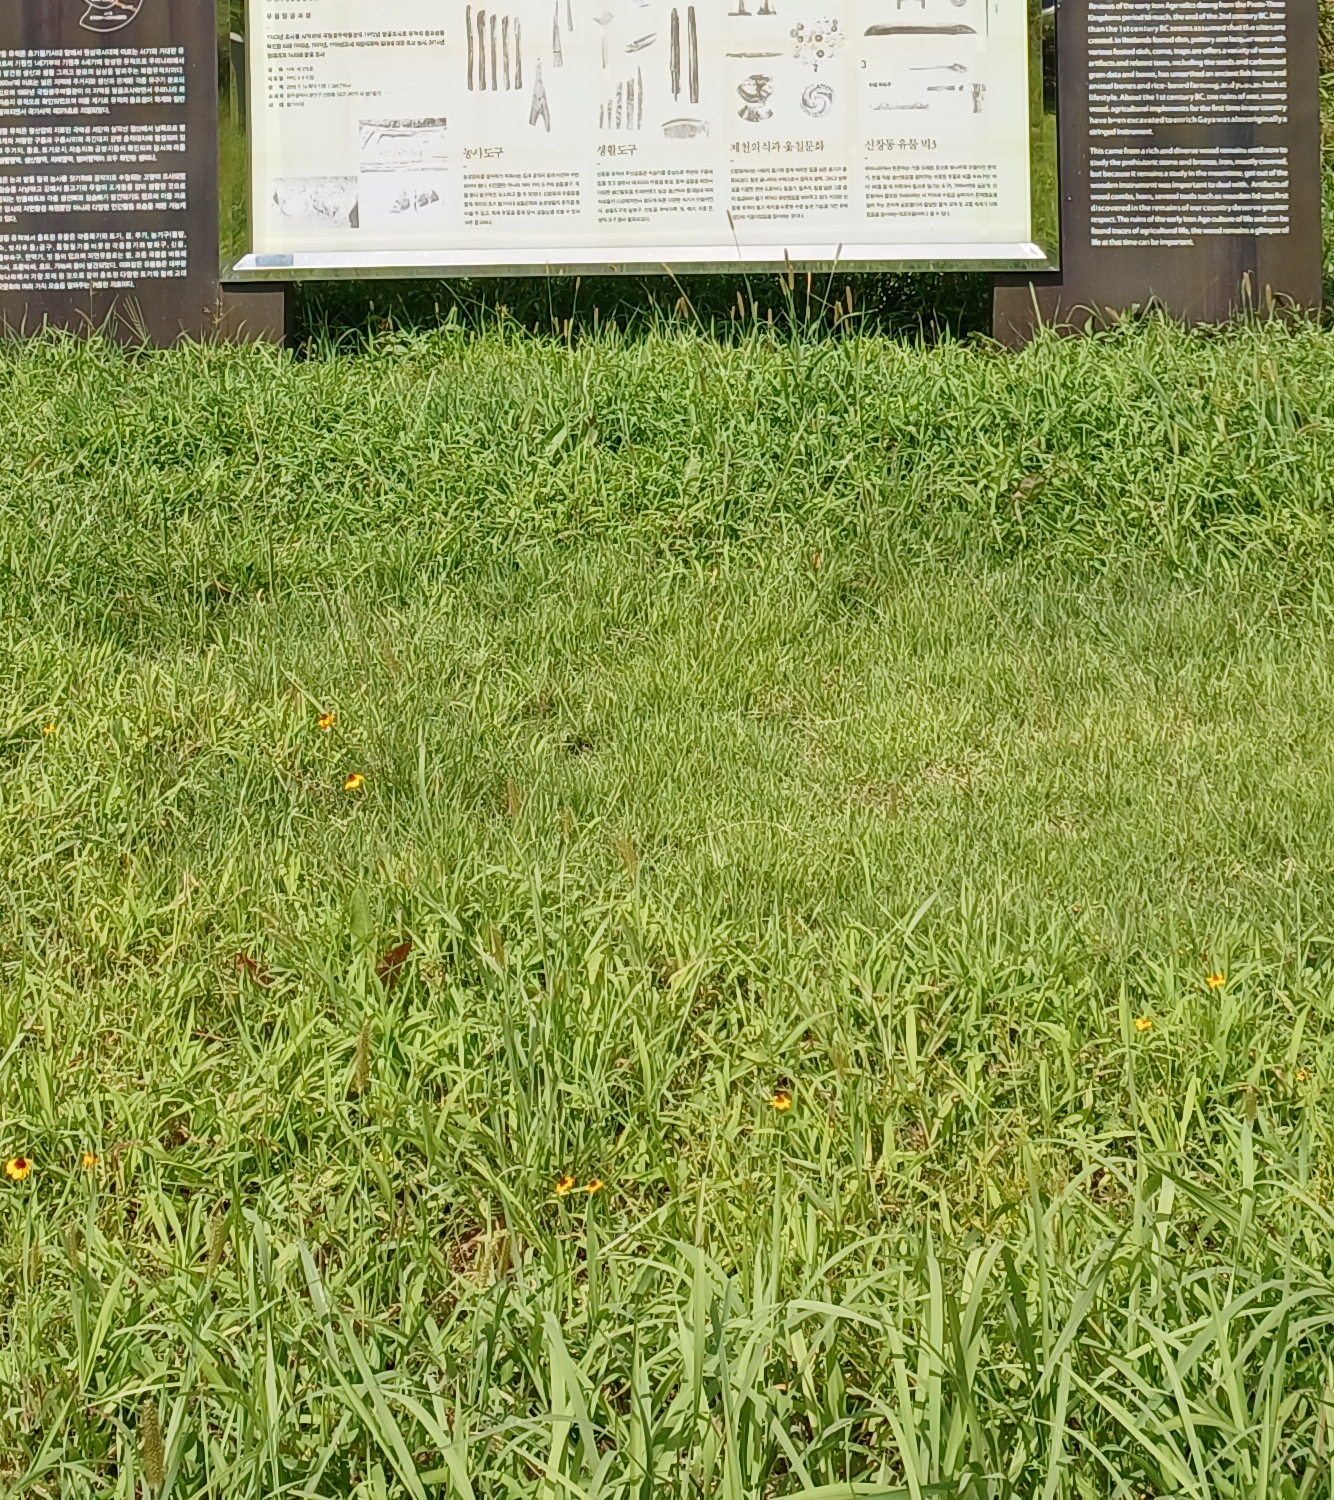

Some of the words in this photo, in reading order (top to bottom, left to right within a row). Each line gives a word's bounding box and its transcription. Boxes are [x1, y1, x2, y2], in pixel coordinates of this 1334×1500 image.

[861, 60, 867, 68] 3
[597, 144, 637, 156] 생활도구
[730, 141, 780, 153] 제천의식과
[864, 138, 895, 151] 신창동
